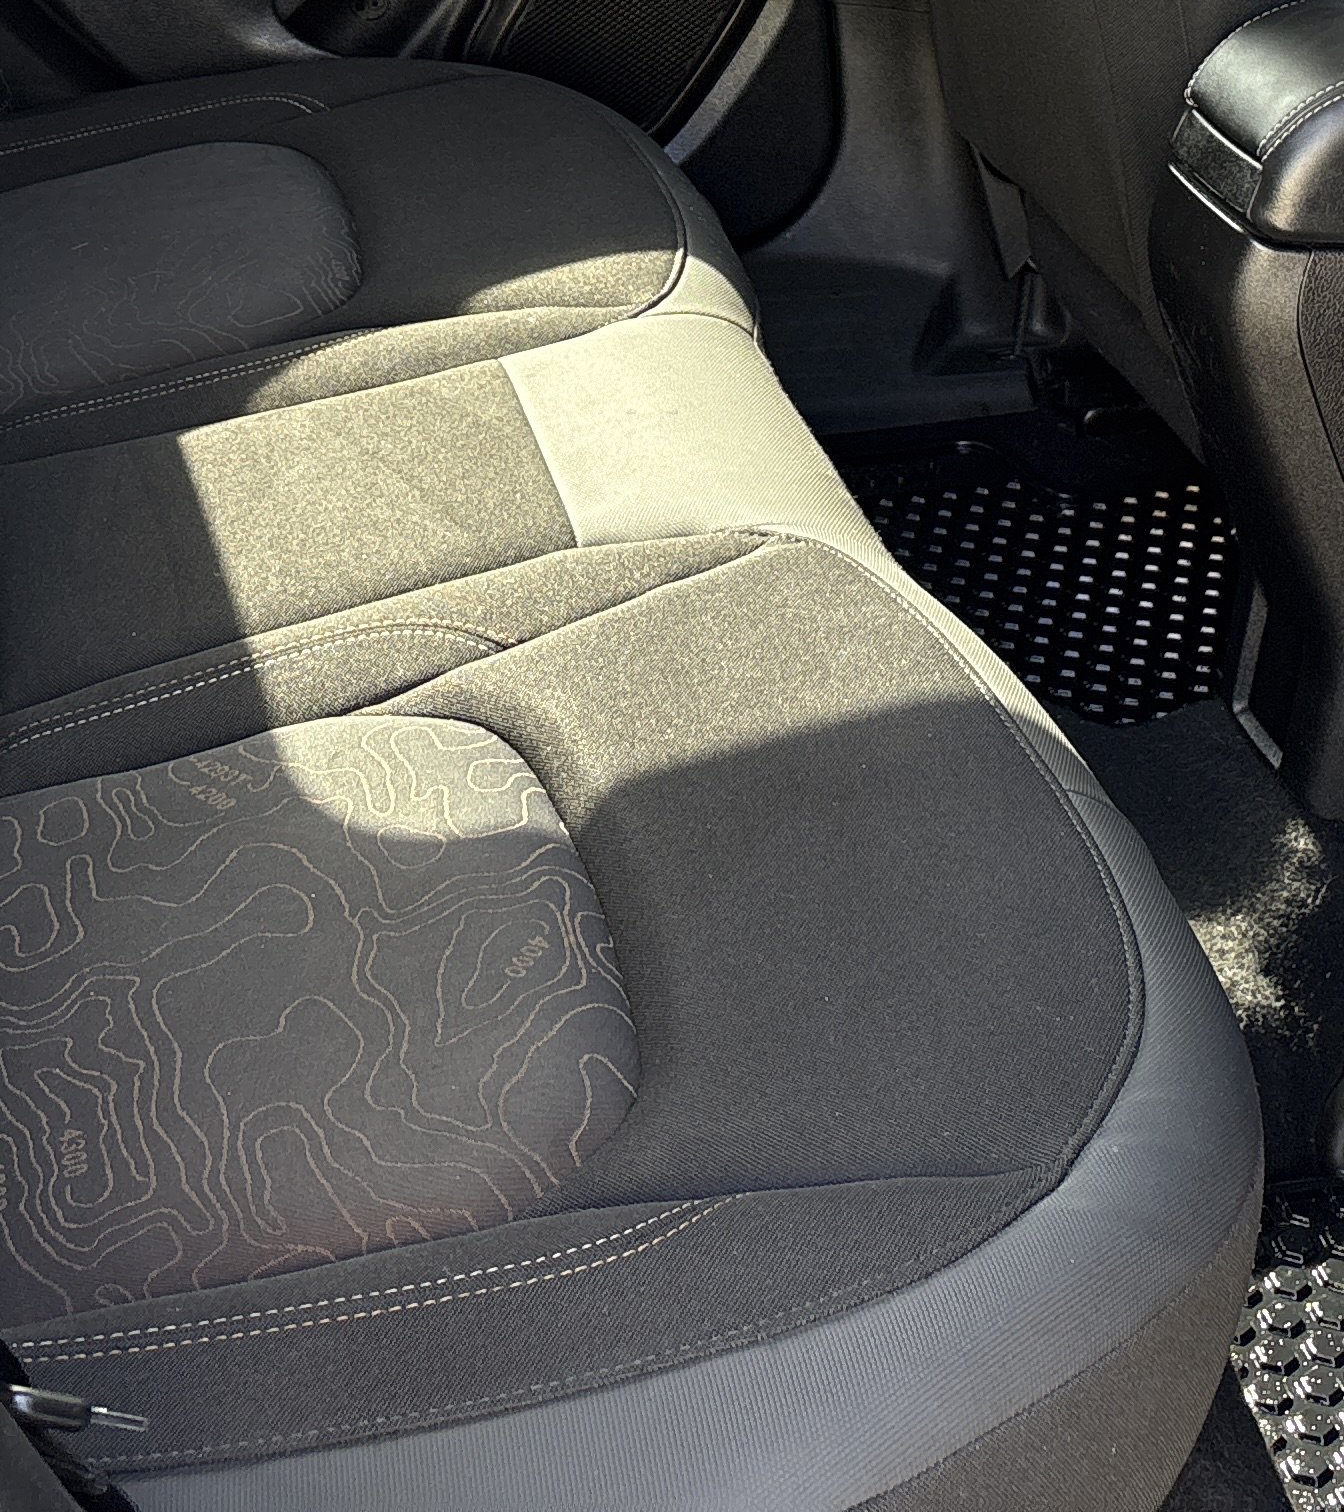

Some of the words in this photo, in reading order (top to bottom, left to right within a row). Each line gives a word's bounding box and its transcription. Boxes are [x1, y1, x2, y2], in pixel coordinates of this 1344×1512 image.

[188, 785, 237, 810] 4200
[503, 935, 551, 978] 4000
[57, 1128, 89, 1179] 4300
